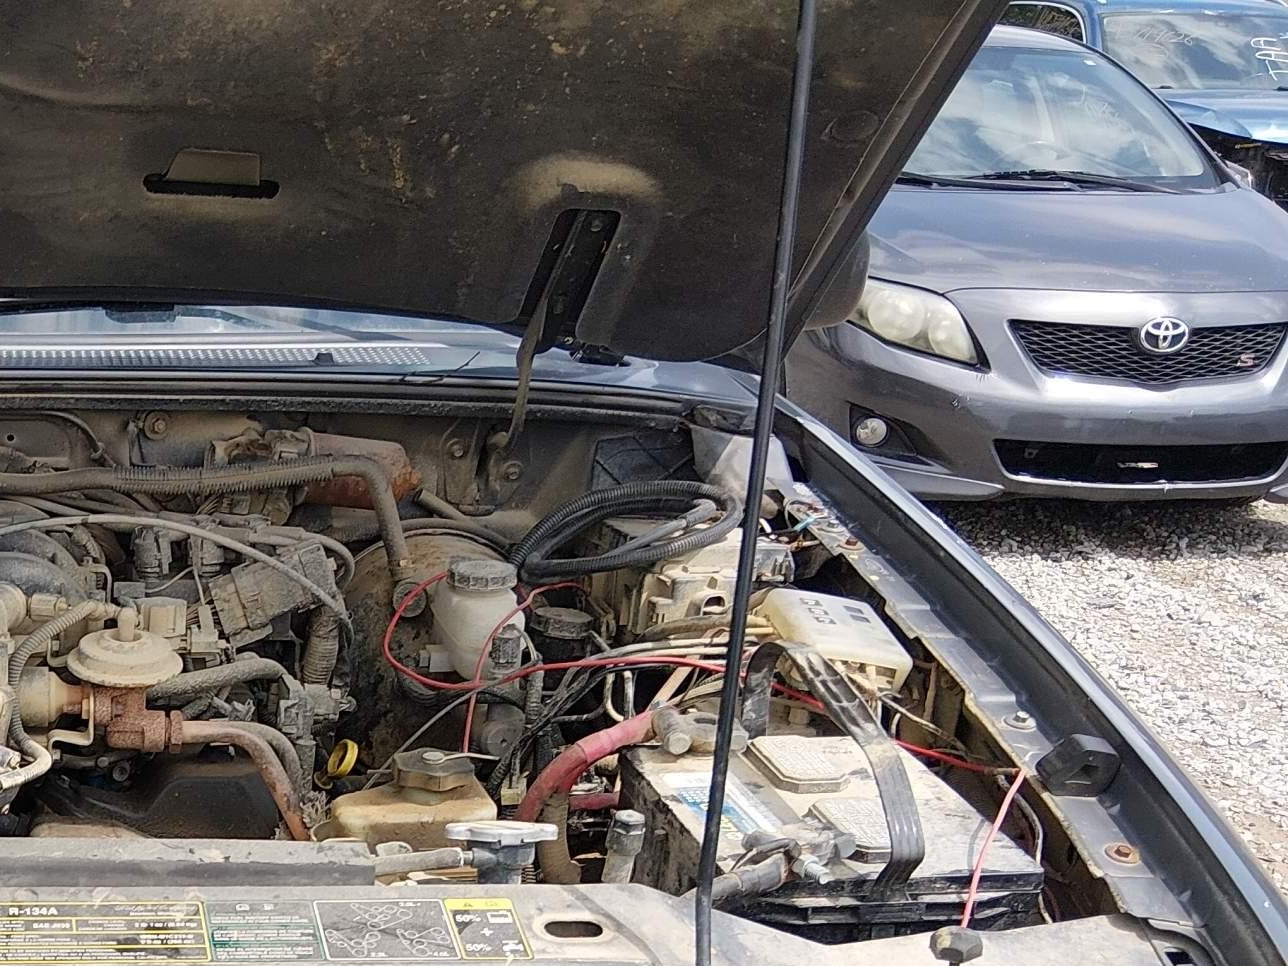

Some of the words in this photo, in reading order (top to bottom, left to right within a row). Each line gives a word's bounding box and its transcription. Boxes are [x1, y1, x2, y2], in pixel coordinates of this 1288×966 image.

[8, 906, 58, 916] R-134A
[455, 913, 482, 922] 50%
[465, 943, 492, 951] 50%
